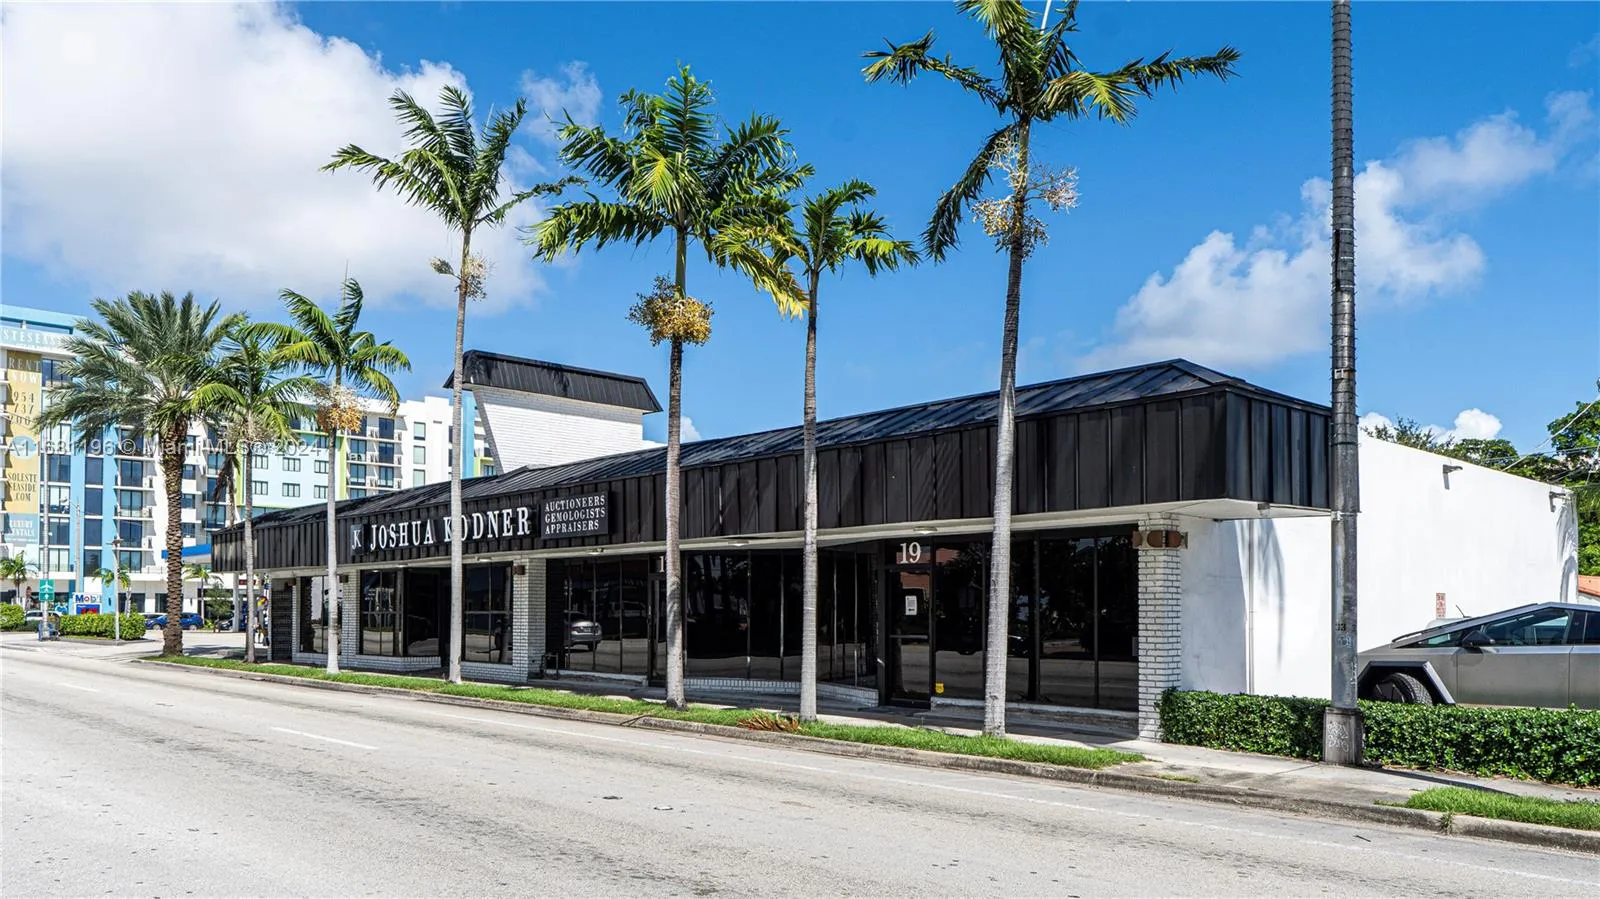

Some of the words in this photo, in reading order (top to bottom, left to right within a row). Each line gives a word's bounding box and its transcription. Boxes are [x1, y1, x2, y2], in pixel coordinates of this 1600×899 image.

[8, 357, 41, 372] RENT
[8, 472, 37, 483] SOLESTE
[545, 495, 605, 512] AUCTIONEERS
[545, 507, 606, 523] GEMOLOGISTS
[370, 519, 434, 550] JOSHUA
[443, 506, 530, 542] KODNER
[545, 519, 599, 535] APPRAISERS
[900, 541, 921, 564] 19
